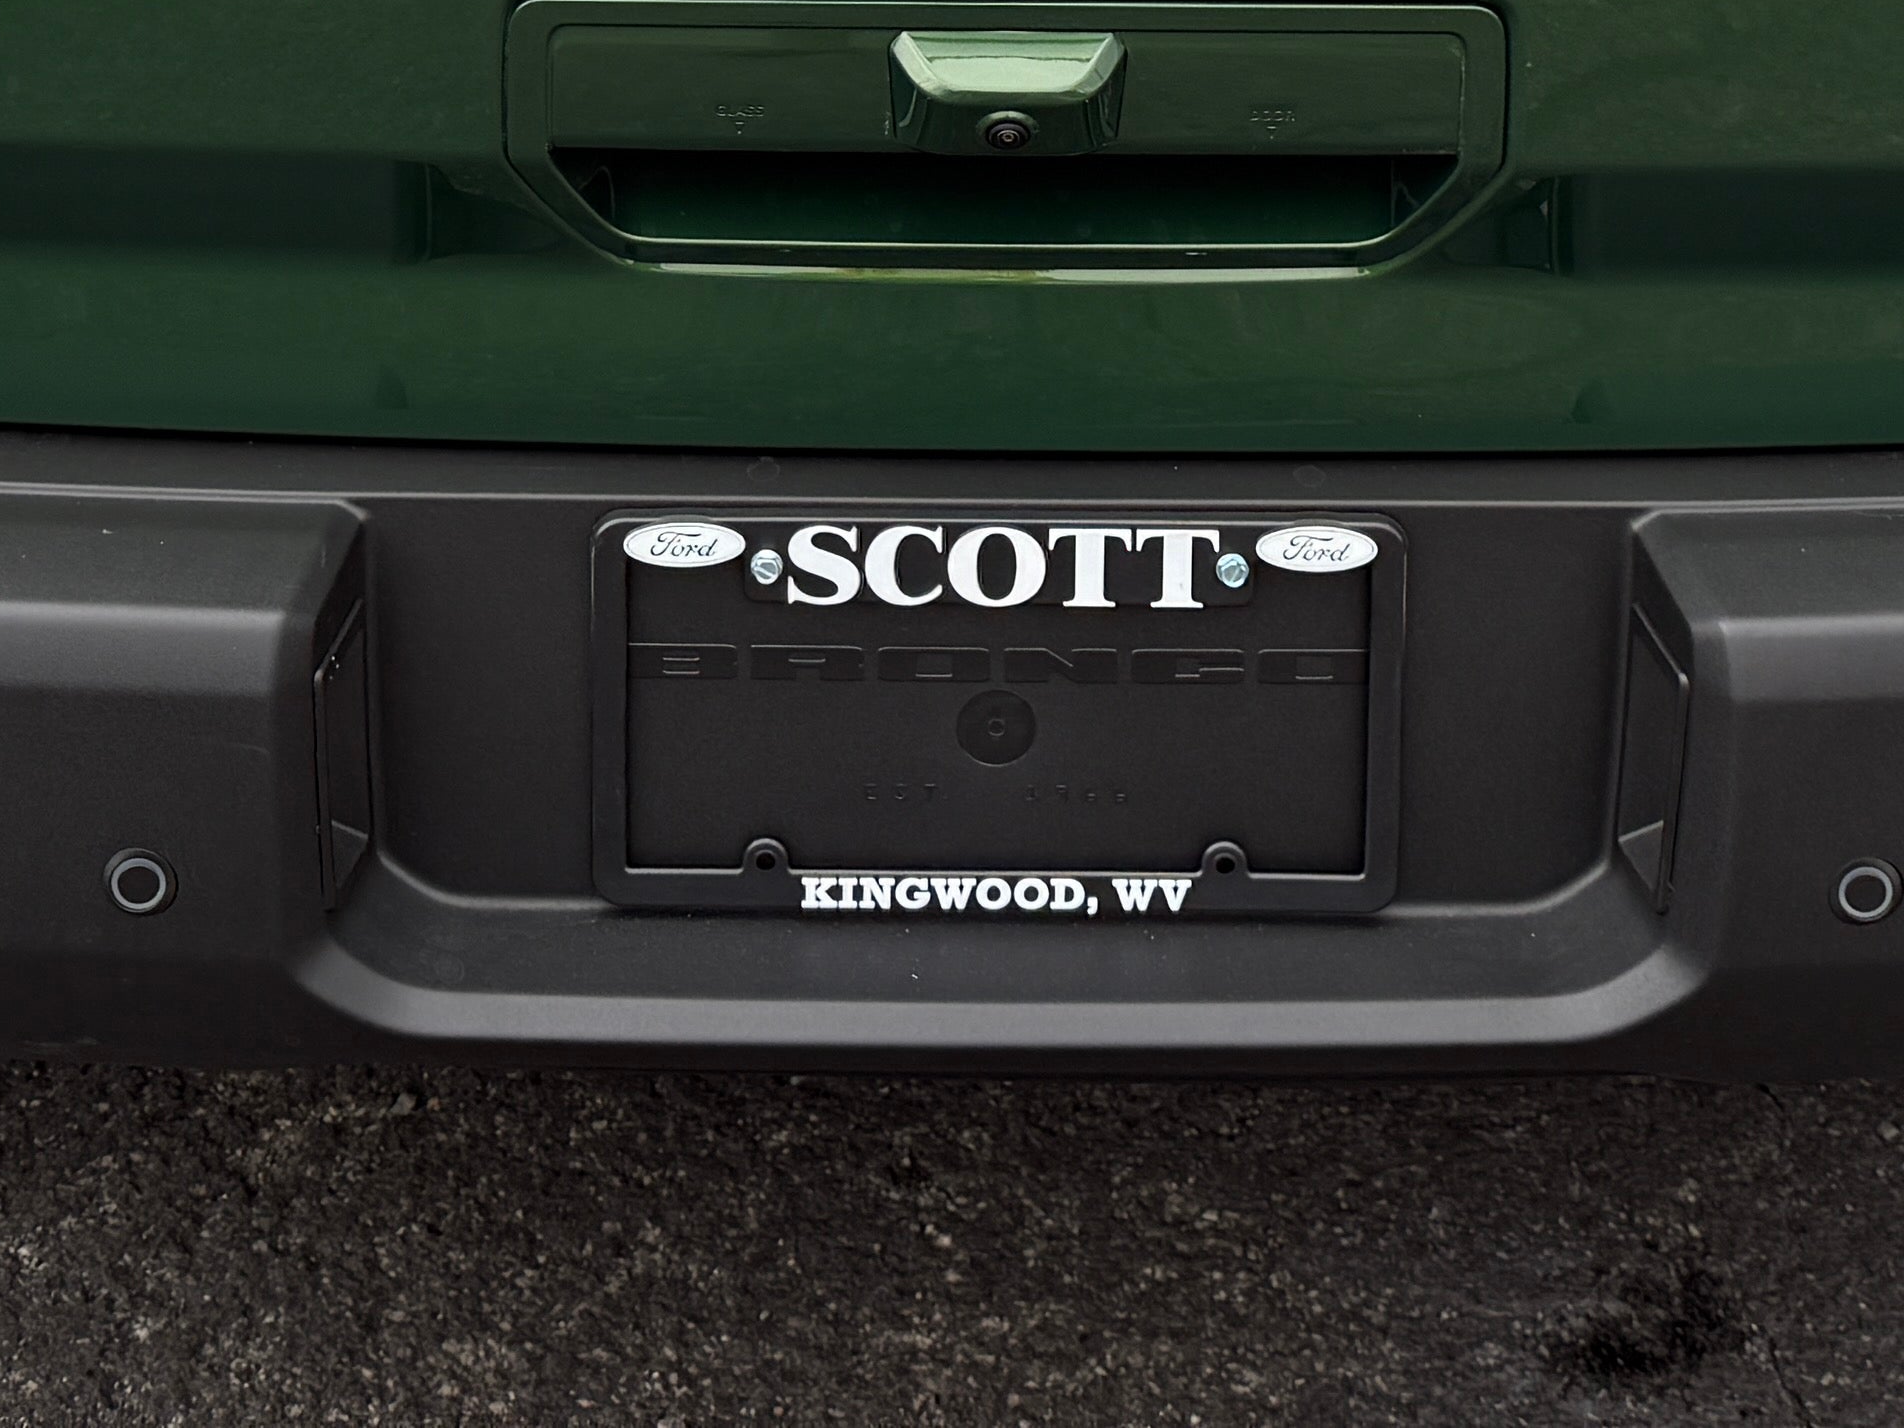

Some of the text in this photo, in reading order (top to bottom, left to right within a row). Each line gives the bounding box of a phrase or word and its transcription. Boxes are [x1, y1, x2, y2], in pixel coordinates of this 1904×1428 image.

[650, 531, 718, 557] Ford
[1283, 535, 1351, 562] Ford
[786, 524, 1221, 609] SCOTT
[628, 643, 1370, 685] BRONCO
[801, 876, 1194, 916] KINGWOOD, WV
